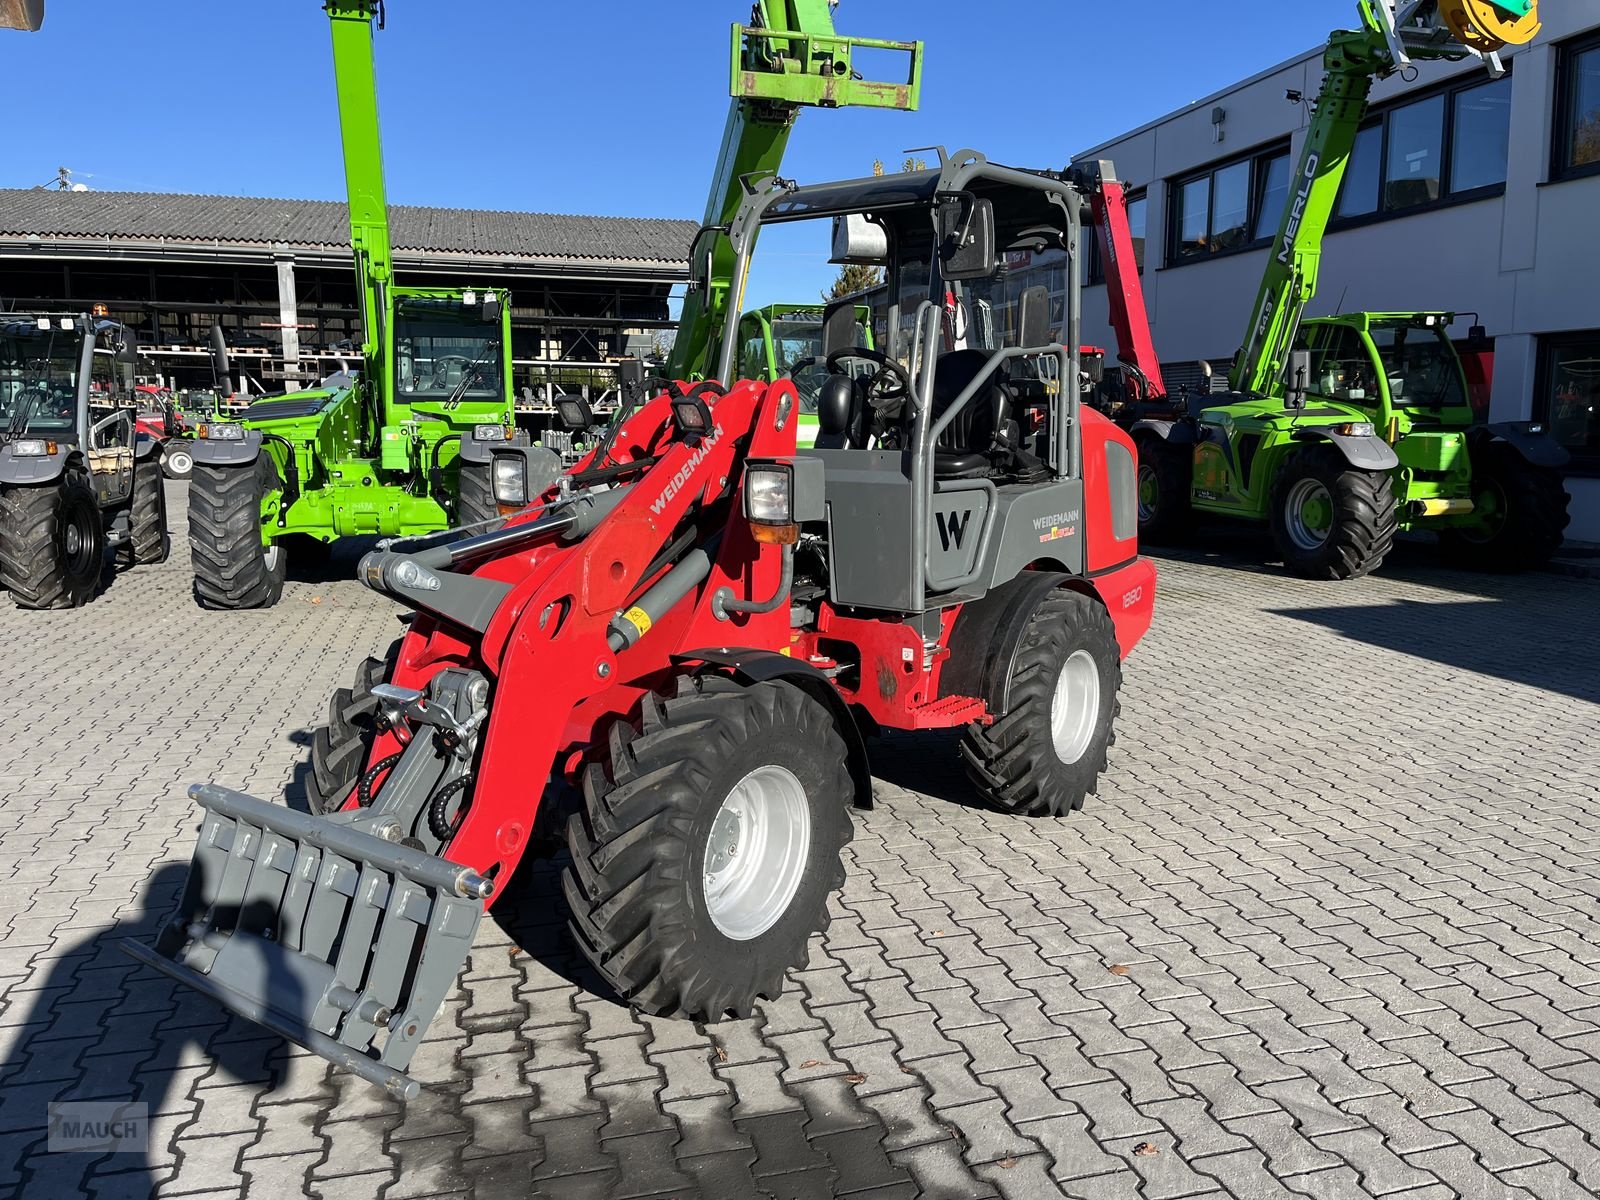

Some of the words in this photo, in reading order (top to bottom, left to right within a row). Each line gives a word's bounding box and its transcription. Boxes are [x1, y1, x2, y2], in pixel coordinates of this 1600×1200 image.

[1277, 153, 1319, 263] MERLO
[1258, 301, 1273, 336] 44.9
[649, 422, 725, 515] WEIDEMANN
[935, 509, 972, 552] W
[1032, 509, 1079, 530] WEIDEMANN
